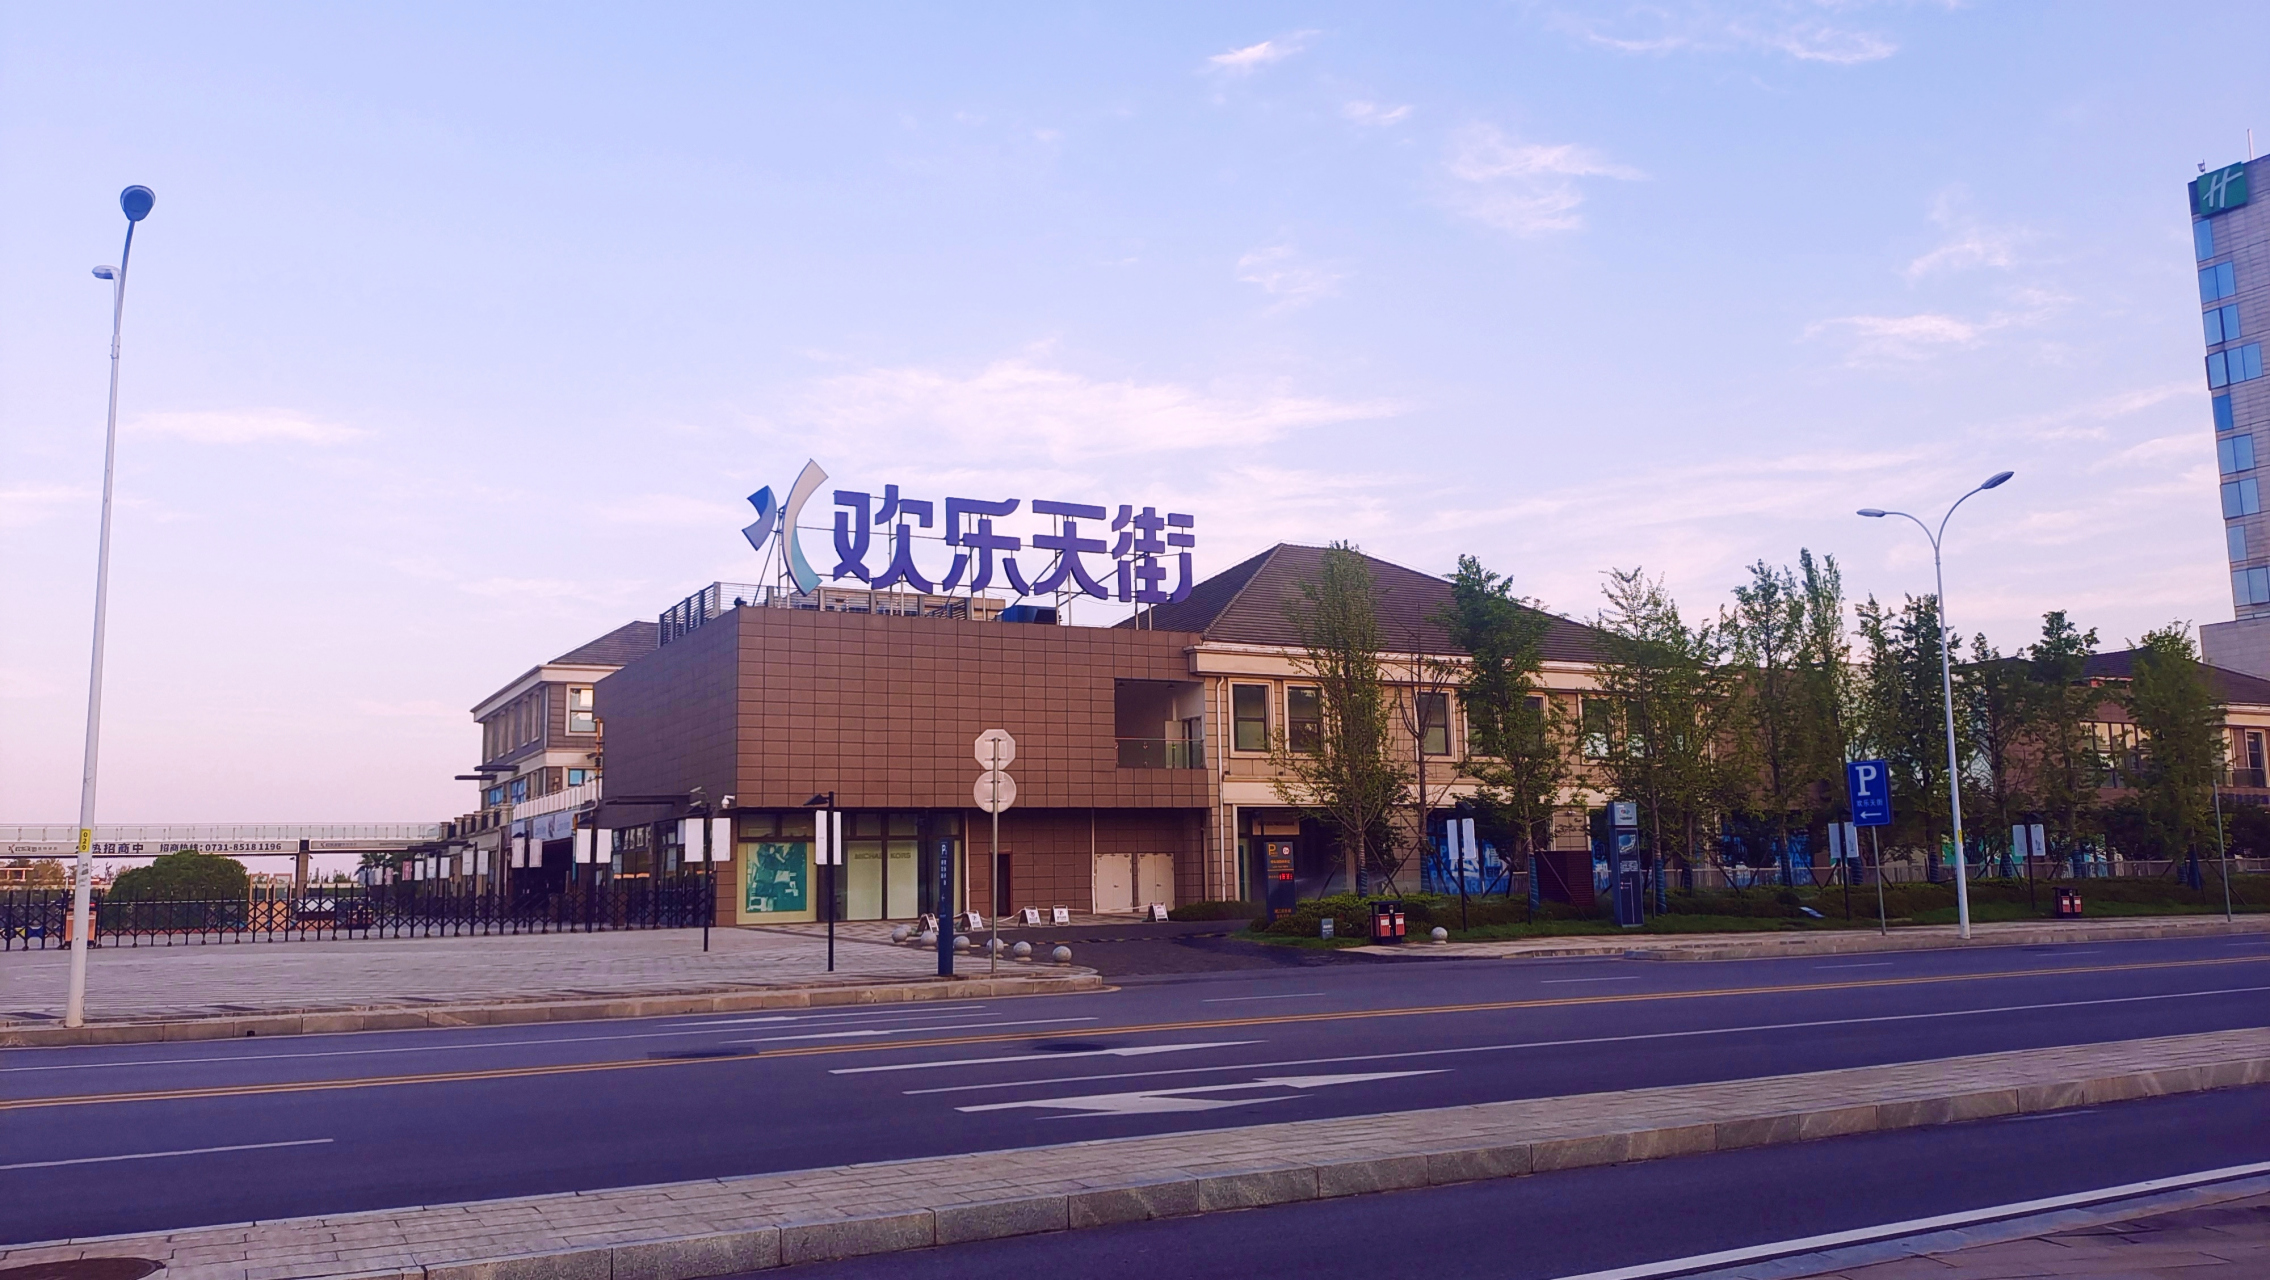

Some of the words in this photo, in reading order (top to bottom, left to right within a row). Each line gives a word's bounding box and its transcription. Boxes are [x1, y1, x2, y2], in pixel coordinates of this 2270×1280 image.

[833, 484, 1195, 604] 欢乐天街
[1855, 765, 1877, 797] P
[1856, 798, 1883, 808] 欢乐天街
[75, 843, 144, 854] 热招商中
